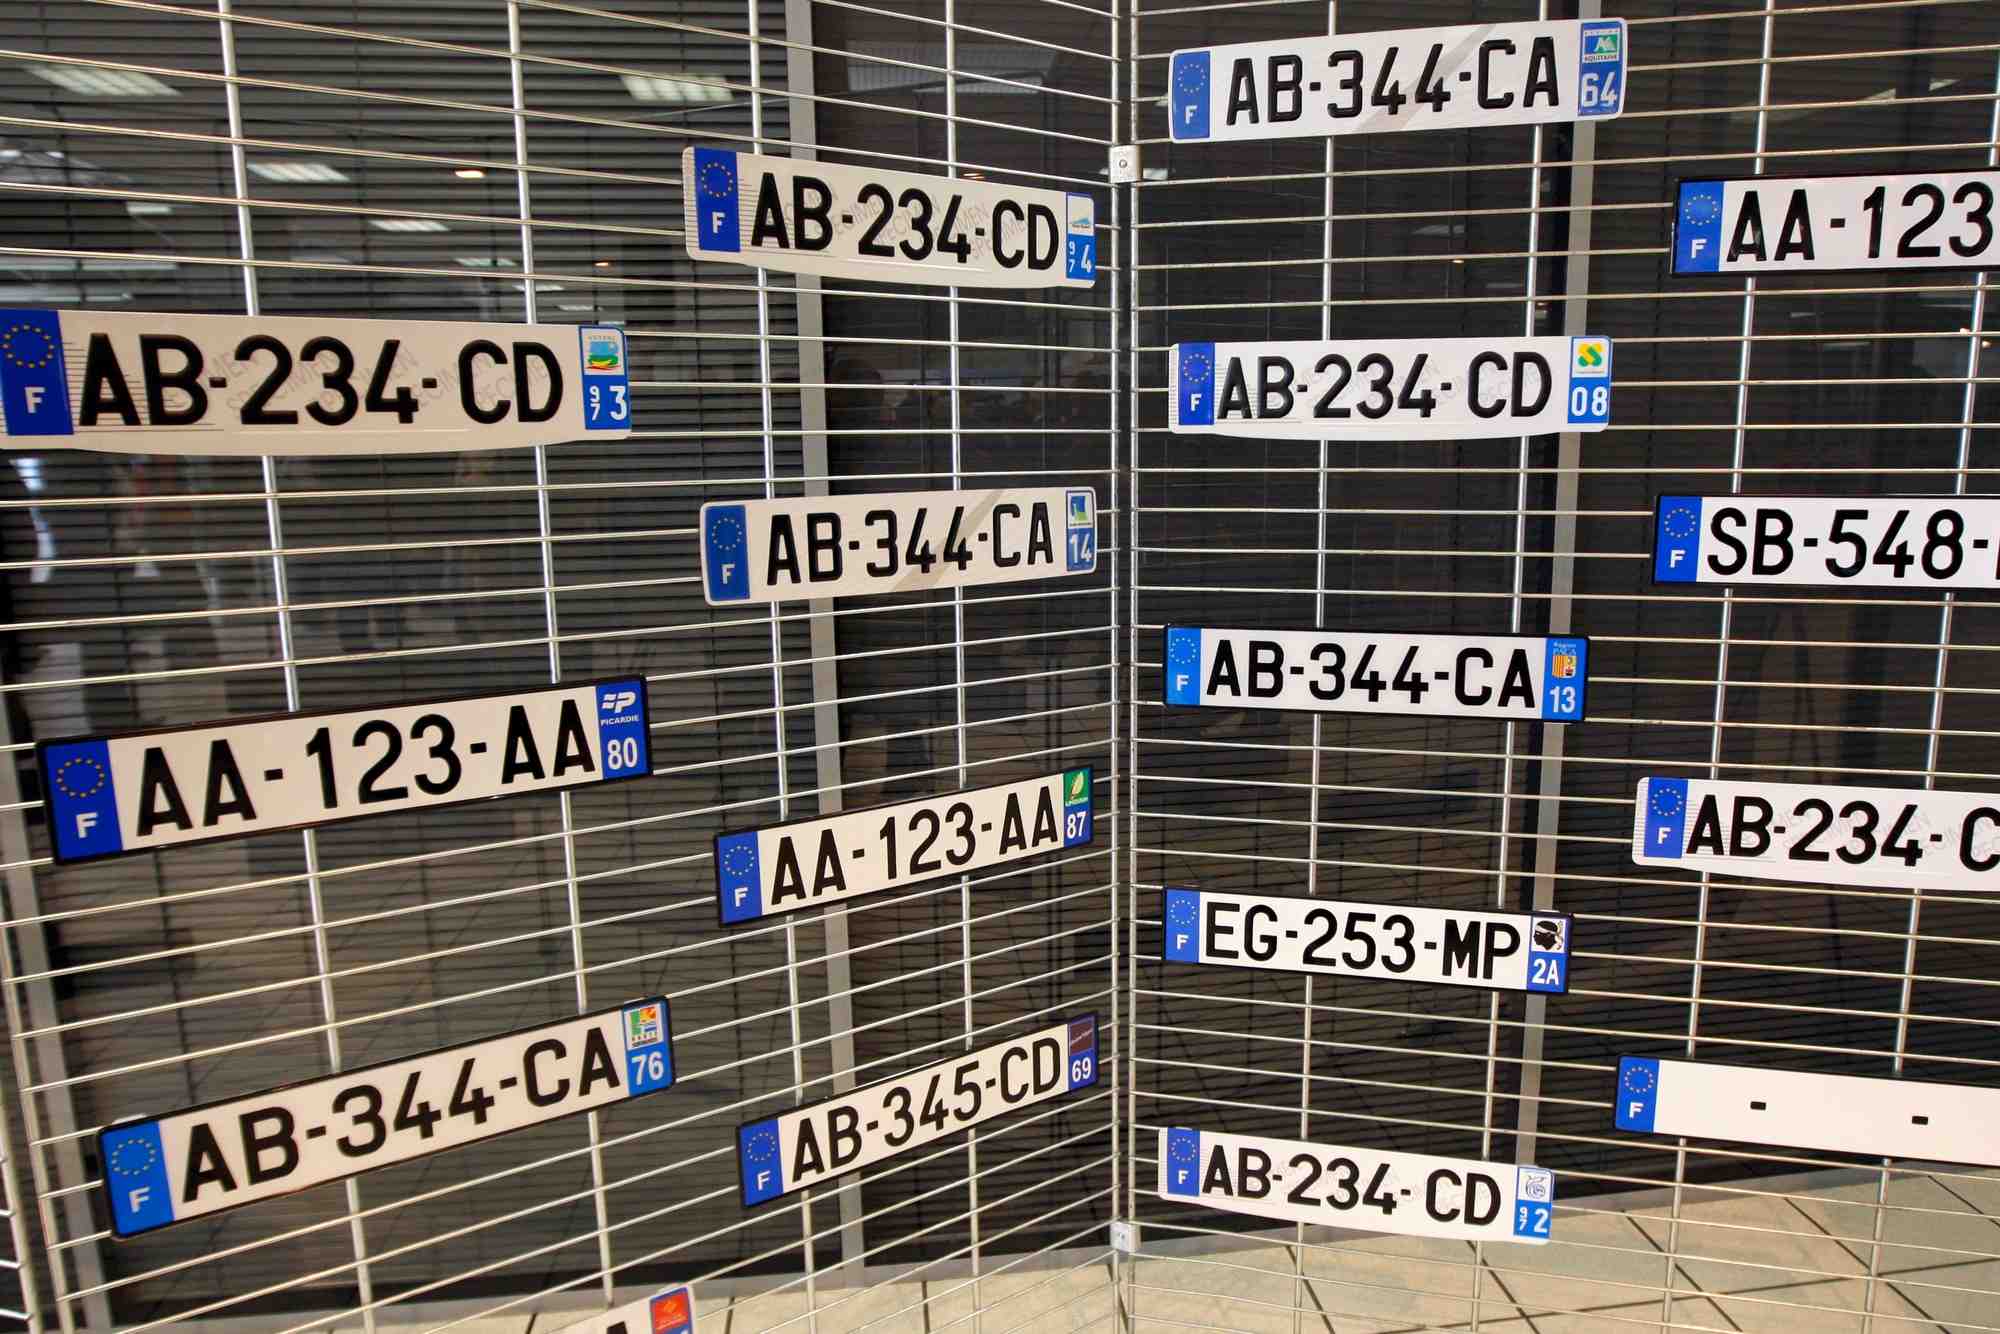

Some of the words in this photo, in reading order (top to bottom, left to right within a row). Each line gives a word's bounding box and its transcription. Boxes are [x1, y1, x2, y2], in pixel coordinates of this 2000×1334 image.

[1226, 36, 1559, 126] AB-344-CA
[1581, 72, 1617, 108] 64
[1185, 105, 1198, 124] F
[712, 211, 724, 233] F
[750, 172, 1059, 271] AB-234-CD
[1726, 181, 1994, 263] AA-123
[1691, 238, 1707, 259] F
[78, 333, 564, 427] AB-234-CD
[1217, 351, 1552, 420] AB-234-CD
[25, 387, 44, 413] F
[1190, 393, 1202, 411] F
[1571, 386, 1608, 417] 08
[766, 502, 1054, 586] AB-344-CA
[1068, 533, 1093, 564] 14
[1707, 507, 2000, 580] SB-548-
[1670, 549, 1686, 568] F
[722, 564, 735, 584] F
[1176, 674, 1189, 691] F
[1206, 639, 1535, 709] AB-344-CA
[1549, 685, 1577, 713] 13
[600, 714, 640, 727] PICARDIE
[607, 736, 638, 770] 80
[137, 699, 596, 837] AA-123-AA
[76, 812, 97, 838] F
[1066, 810, 1087, 839] 87
[1657, 827, 1672, 845] F
[771, 785, 1058, 906] AA-123-AA
[734, 886, 748, 907] F
[1176, 933, 1189, 950] F
[1205, 901, 1521, 980] EG-253-MP
[1531, 958, 1560, 985] 2A
[631, 1051, 664, 1086] 76
[1071, 1056, 1092, 1083] 69
[183, 1027, 620, 1203] AB-344-CA
[792, 1037, 1061, 1182] AB-345-CD
[1629, 1102, 1644, 1118] F
[757, 1170, 770, 1190] F
[1178, 1169, 1189, 1185] F
[1202, 1144, 1501, 1226] AB-234-CD
[130, 1187, 148, 1211] F
